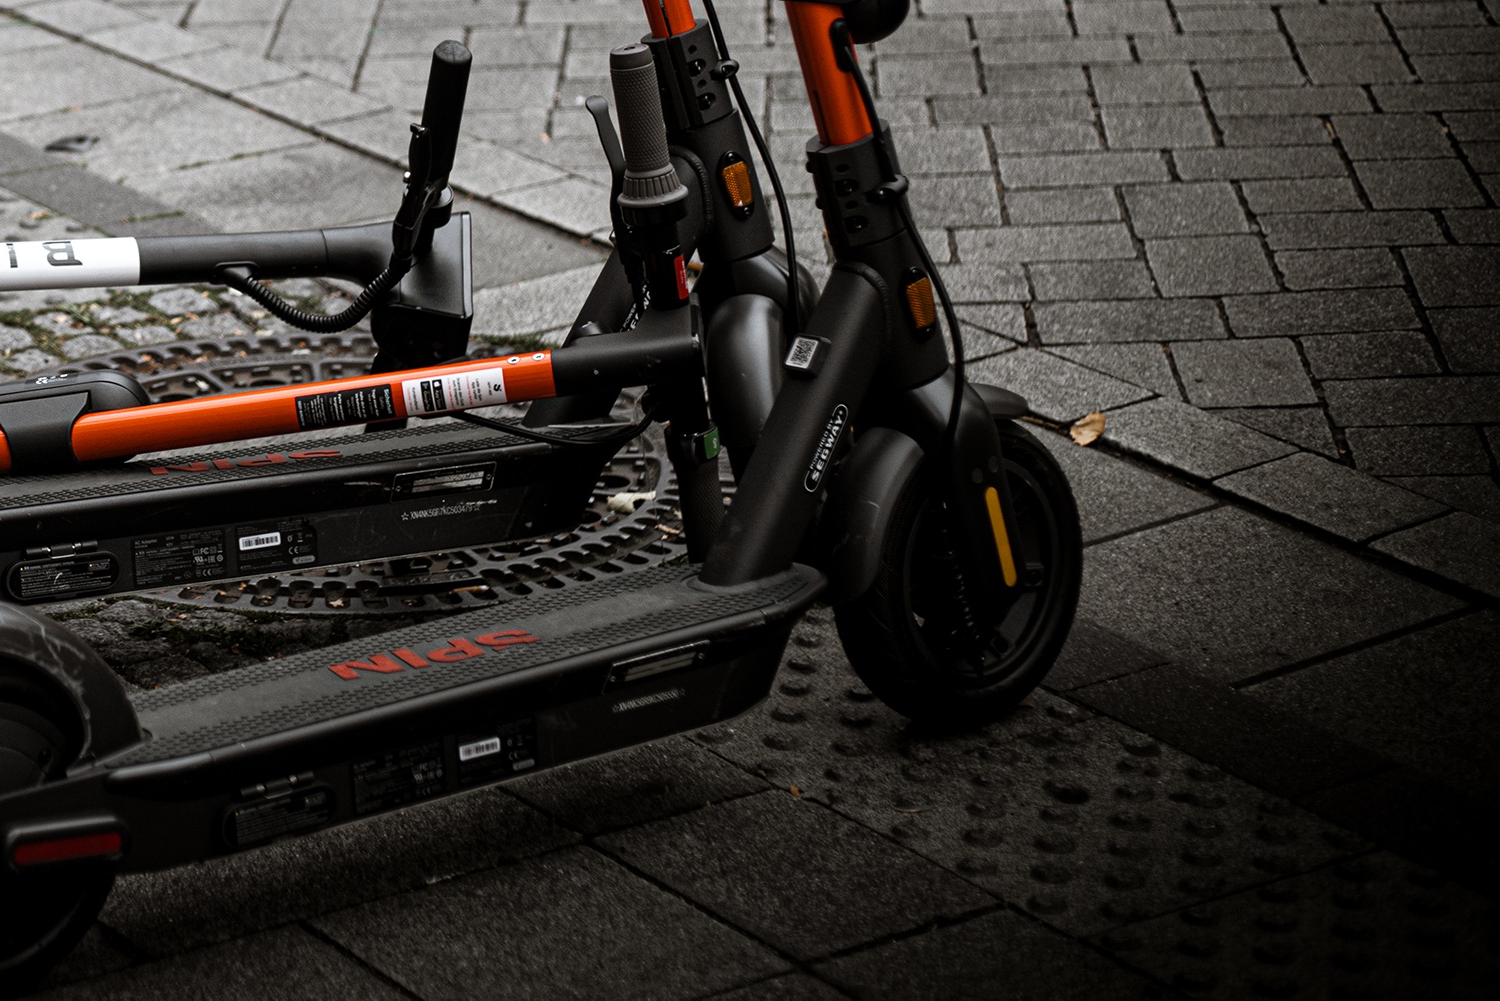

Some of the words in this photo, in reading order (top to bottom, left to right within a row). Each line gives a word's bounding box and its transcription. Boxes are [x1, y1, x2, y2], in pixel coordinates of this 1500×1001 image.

[150, 450, 342, 476] SPIN
[811, 415, 843, 482] SEGWAY
[328, 629, 541, 681] SPIN
